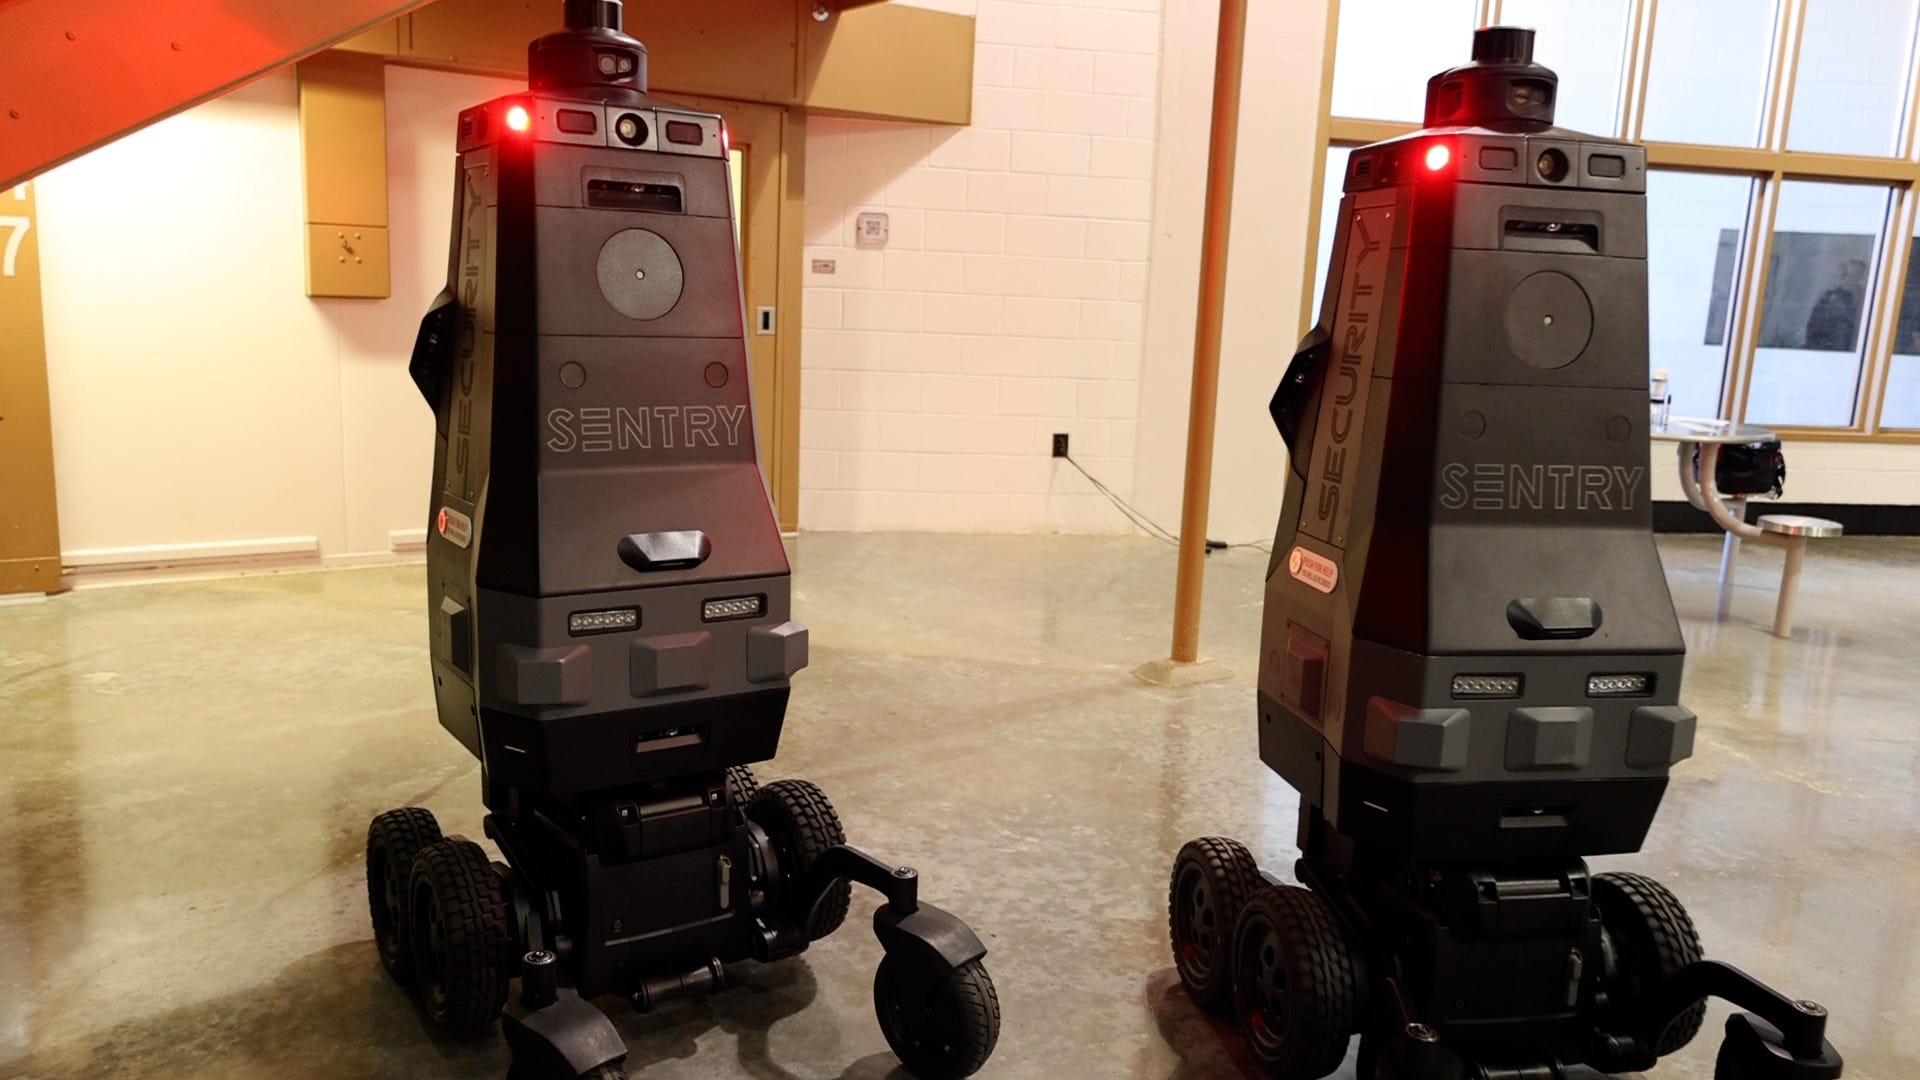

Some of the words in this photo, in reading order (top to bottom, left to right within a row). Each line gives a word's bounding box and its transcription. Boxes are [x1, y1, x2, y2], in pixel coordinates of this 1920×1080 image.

[455, 178, 483, 476] SECURITY
[1318, 216, 1381, 524] SECURITY
[547, 404, 747, 453] SENTRY
[1440, 462, 1645, 510] SENTRY
